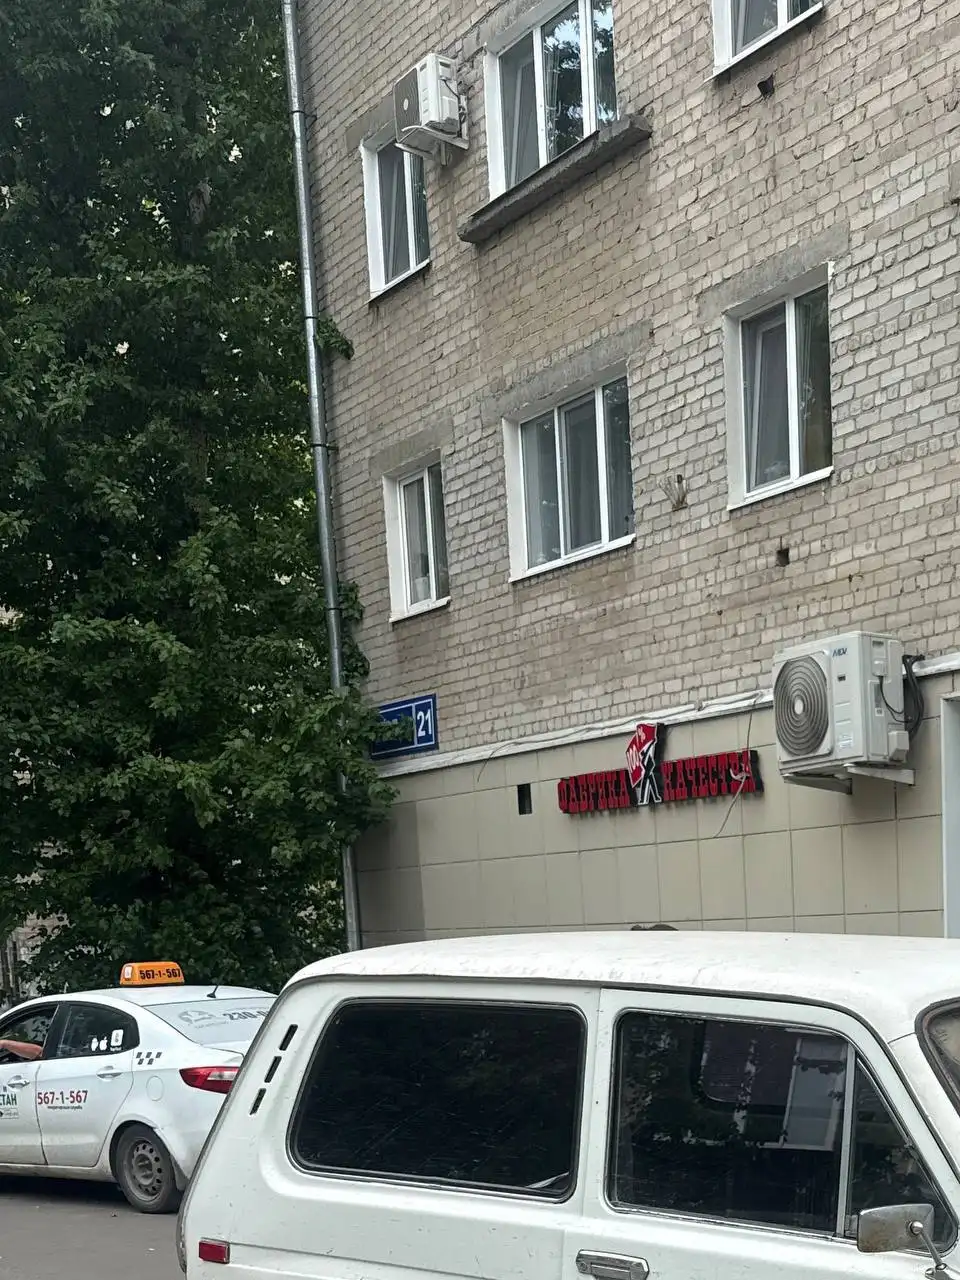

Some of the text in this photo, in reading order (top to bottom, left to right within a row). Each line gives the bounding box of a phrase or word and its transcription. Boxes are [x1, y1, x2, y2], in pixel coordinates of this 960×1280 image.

[416, 709, 432, 737] 21
[558, 750, 756, 814] ФАБРИКА КАЧЕСТВА
[140, 968, 181, 980] 567-1-567
[38, 1089, 88, 1106] 567-1-567
